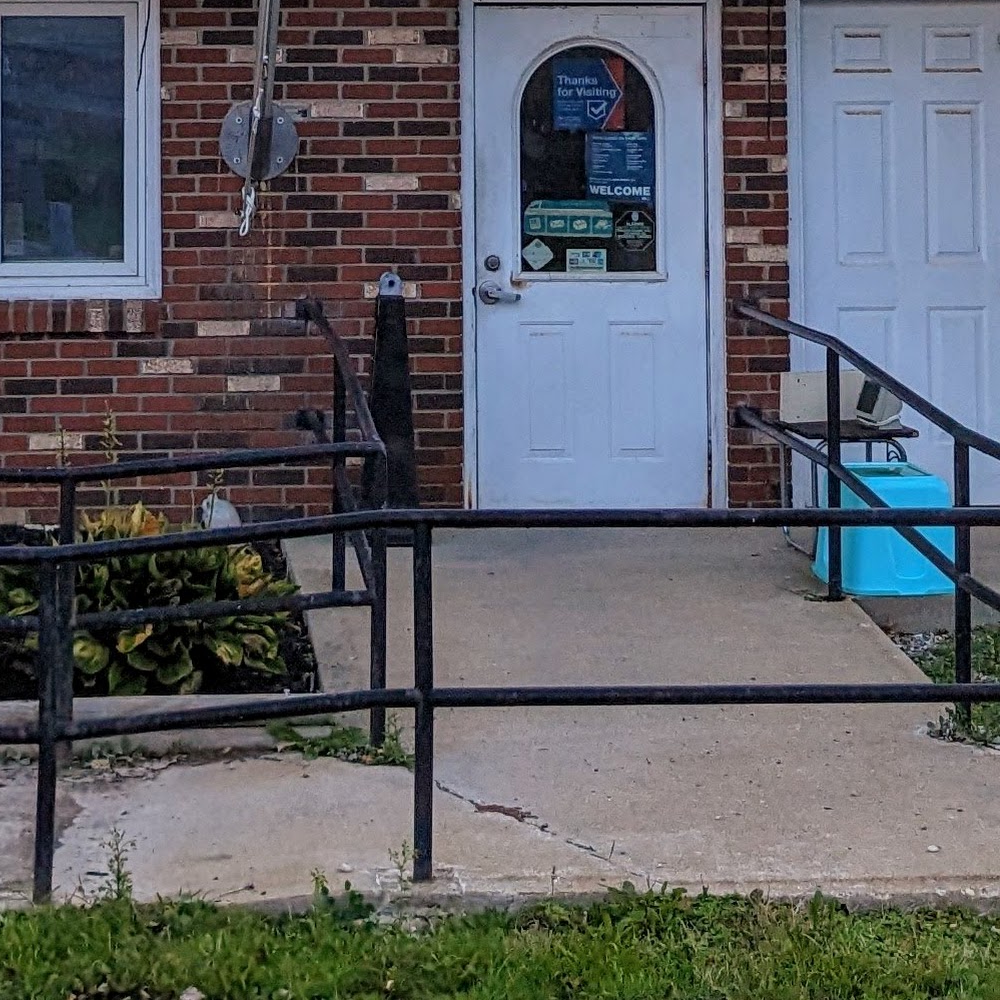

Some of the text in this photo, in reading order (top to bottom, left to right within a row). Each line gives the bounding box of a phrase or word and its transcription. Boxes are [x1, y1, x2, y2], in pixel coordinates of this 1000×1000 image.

[557, 75, 598, 85] Thanks
[557, 87, 617, 99] for Visiting
[590, 185, 651, 197] WELCOME
